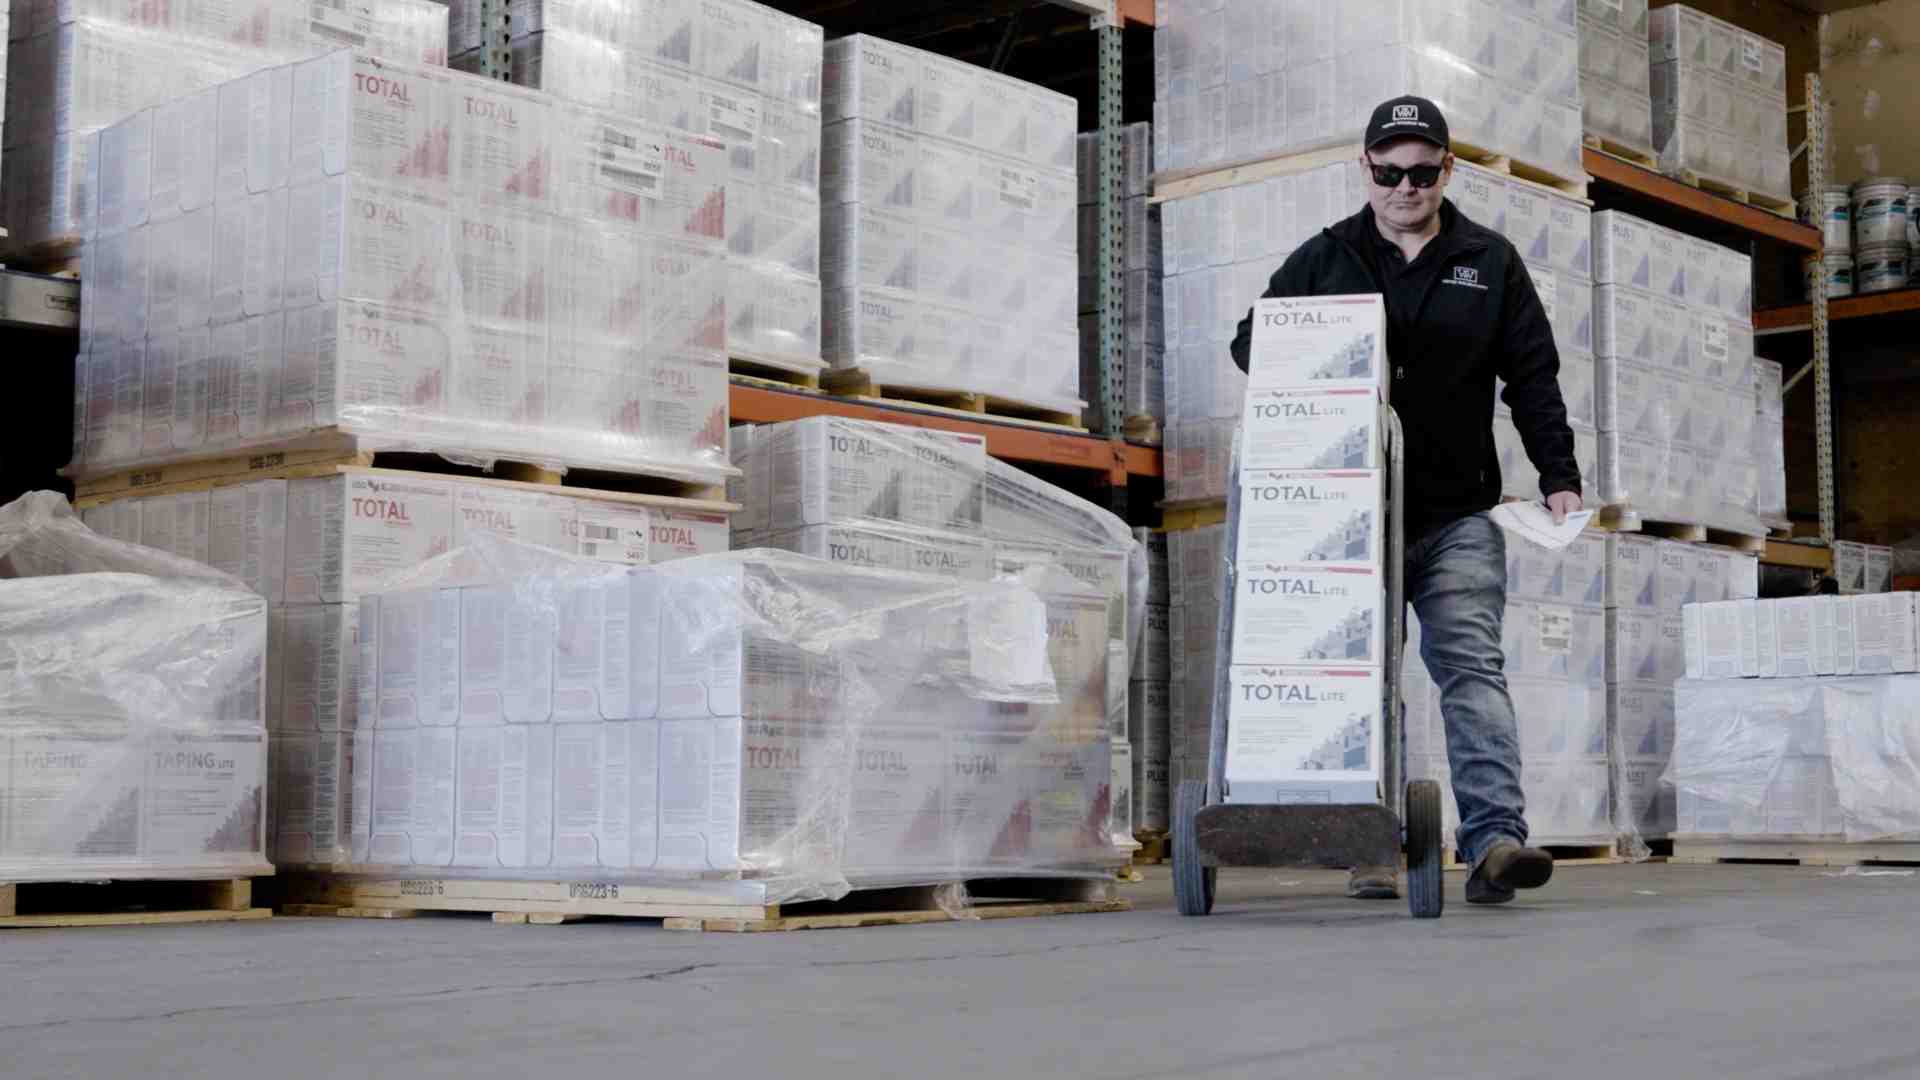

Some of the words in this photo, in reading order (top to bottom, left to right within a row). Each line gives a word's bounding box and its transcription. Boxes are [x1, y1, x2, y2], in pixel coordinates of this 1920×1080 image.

[353, 72, 412, 101] TOTAL
[463, 96, 519, 124] TOTAL
[664, 143, 696, 167] TAL
[353, 198, 408, 224] TOTAL
[459, 219, 518, 245] TOTAL
[861, 301, 893, 318] TOTAL
[1263, 311, 1328, 326] TOTAL
[1330, 315, 1352, 324] LITE
[346, 322, 402, 351] TOTAL
[1253, 402, 1320, 418] TOTAL
[1323, 407, 1345, 416] LITE
[829, 435, 873, 456] TOTAL
[1250, 486, 1320, 501] TOTAL
[1324, 490, 1348, 500] LITE
[352, 498, 410, 521] TOTAL
[461, 508, 516, 530] TOTAL
[650, 526, 696, 546] TOTAL
[829, 544, 873, 562] TOTAL
[915, 550, 956, 569] TOTAL
[1248, 579, 1320, 595] TOTAL
[1323, 586, 1350, 596] LITE
[1241, 684, 1317, 701] TOTAL
[1321, 691, 1345, 702] LITE
[24, 751, 89, 769] TAPING
[154, 751, 216, 769] TAPING
[746, 746, 801, 769] TOTAL
[856, 750, 907, 771] TOTAL
[952, 755, 998, 775] TOTAL
